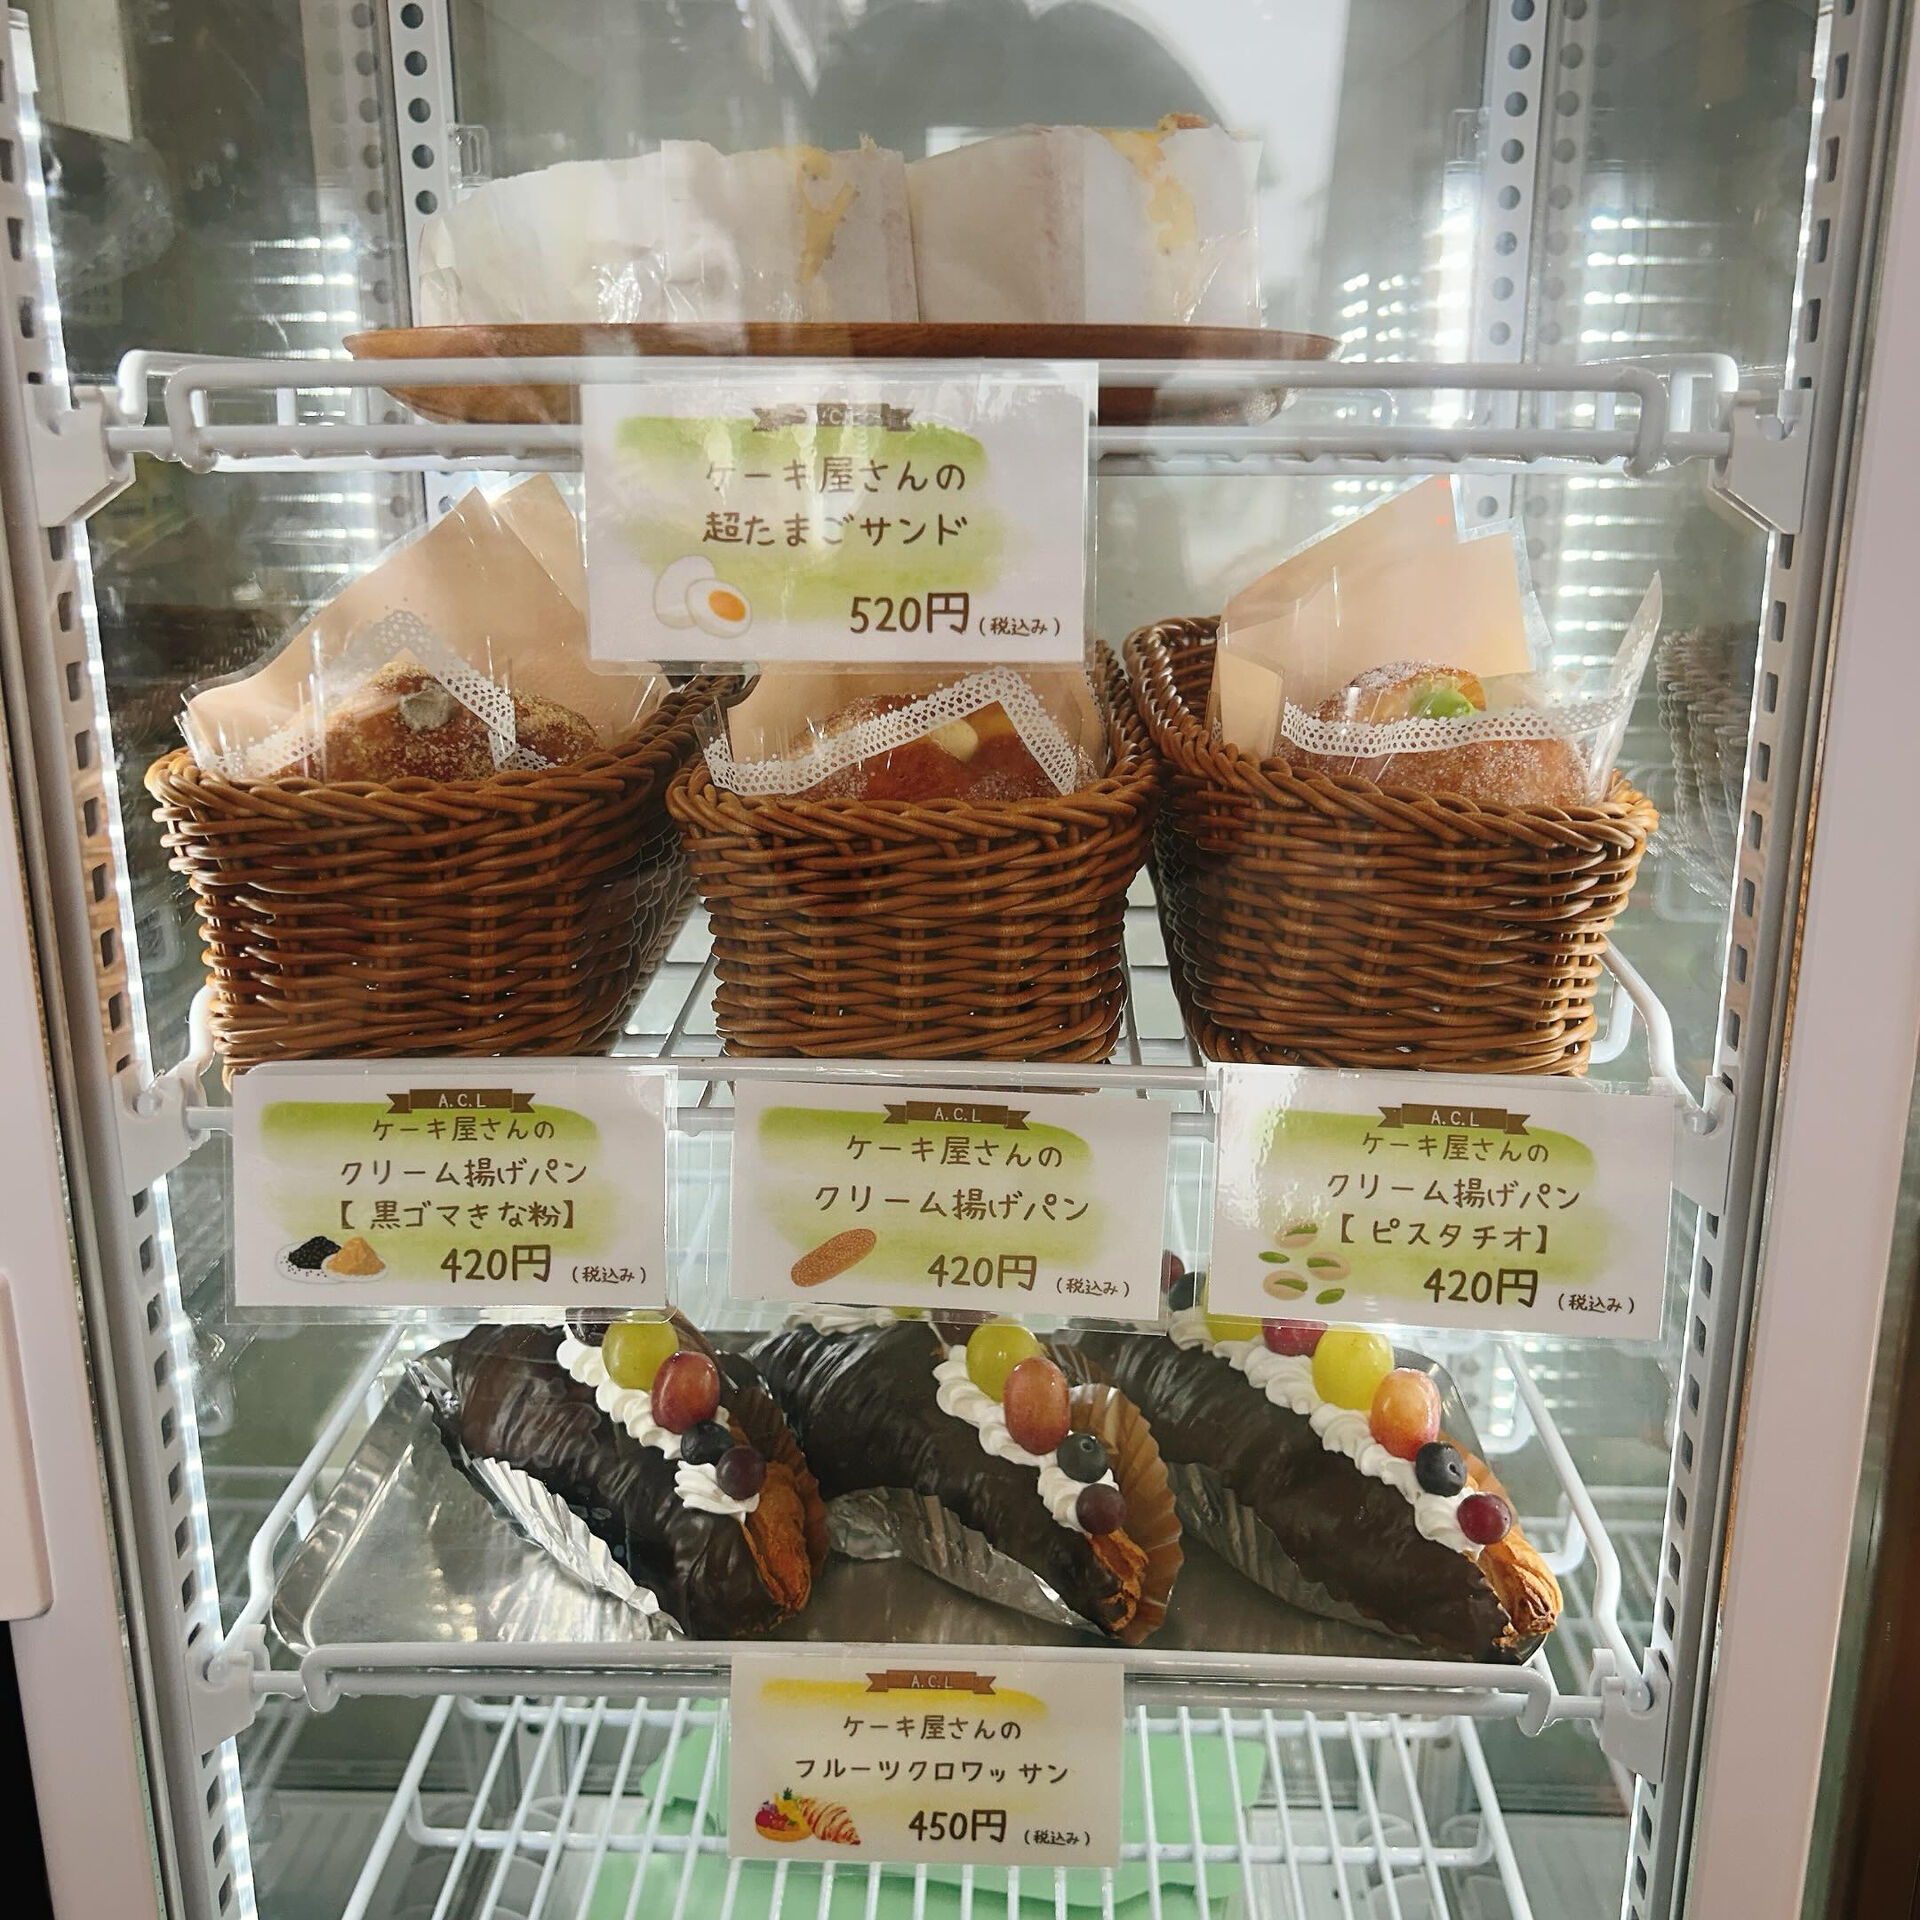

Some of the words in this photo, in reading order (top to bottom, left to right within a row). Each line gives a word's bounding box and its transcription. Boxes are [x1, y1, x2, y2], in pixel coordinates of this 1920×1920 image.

[706, 456, 967, 493] ケーキ屋さんの
[702, 510, 968, 547] 超たまごサンド
[850, 592, 969, 635] 520円
[979, 617, 1061, 638] (税込み)
[438, 1093, 487, 1109] A.C.L
[933, 1107, 982, 1123] A.C.L
[372, 1116, 555, 1142] ケーキ屋さんの
[1430, 1110, 1480, 1127] A.C.L
[847, 1135, 1063, 1168] ケーキ屋さんの
[1362, 1132, 1549, 1163] ケーキ屋さんの
[340, 1157, 587, 1187] クリーム揚げパン
[815, 1185, 1089, 1222] クリーム揚げパン
[1328, 1172, 1581, 1211] クリーム揚げパン
[340, 1199, 574, 1230] 【黒ゴマきな粉】
[1341, 1213, 1548, 1255] 【ピスタチオ】
[440, 1244, 551, 1284] 420円
[572, 1266, 647, 1284] (税込み)
[928, 1254, 1037, 1290] 420円
[1056, 1276, 1130, 1297] (税込み)
[1424, 1267, 1538, 1308] 420円
[1558, 1292, 1636, 1314] (税込み)
[911, 1675, 954, 1689] A.C.L
[843, 1715, 1021, 1740] ケーキ屋さんの
[795, 1757, 1068, 1784] フルーツクロワッサン
[909, 1809, 1006, 1843] 450円
[1024, 1830, 1091, 1847] (税込み)
